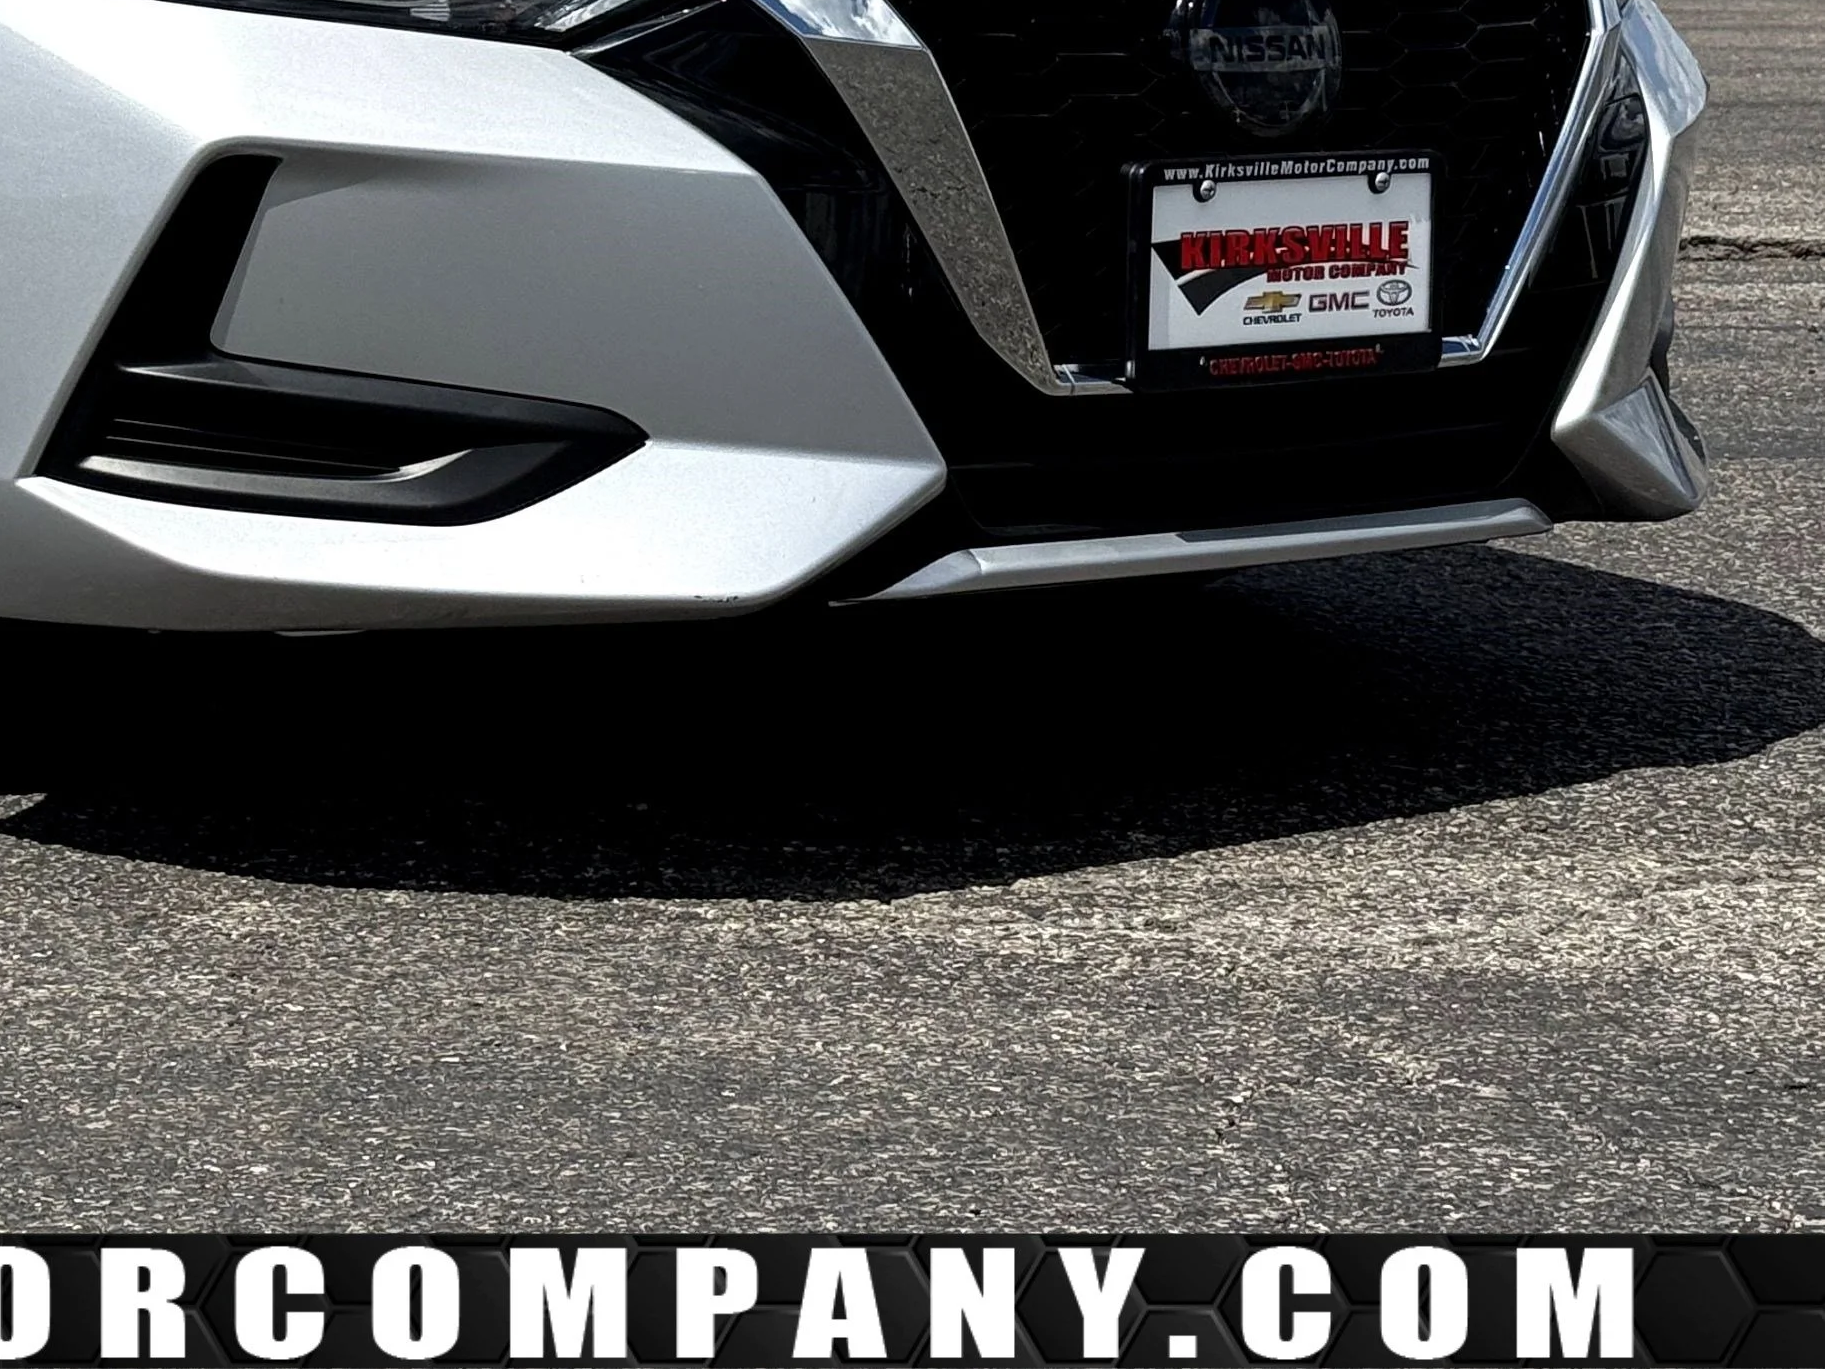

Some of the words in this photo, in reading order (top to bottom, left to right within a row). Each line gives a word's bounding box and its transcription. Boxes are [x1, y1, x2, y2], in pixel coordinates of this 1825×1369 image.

[1208, 33, 1327, 63] NISSAN
[1162, 156, 1431, 182] www.KirksvilleMotorCompany.com
[1180, 220, 1410, 272] KIRKSVILLE
[1266, 265, 1326, 284] MOTOR
[1328, 260, 1408, 280] COMPANY
[1307, 290, 1371, 313] GMC
[1372, 306, 1415, 319] TOYOTA
[1242, 312, 1303, 326] CHEVROLET
